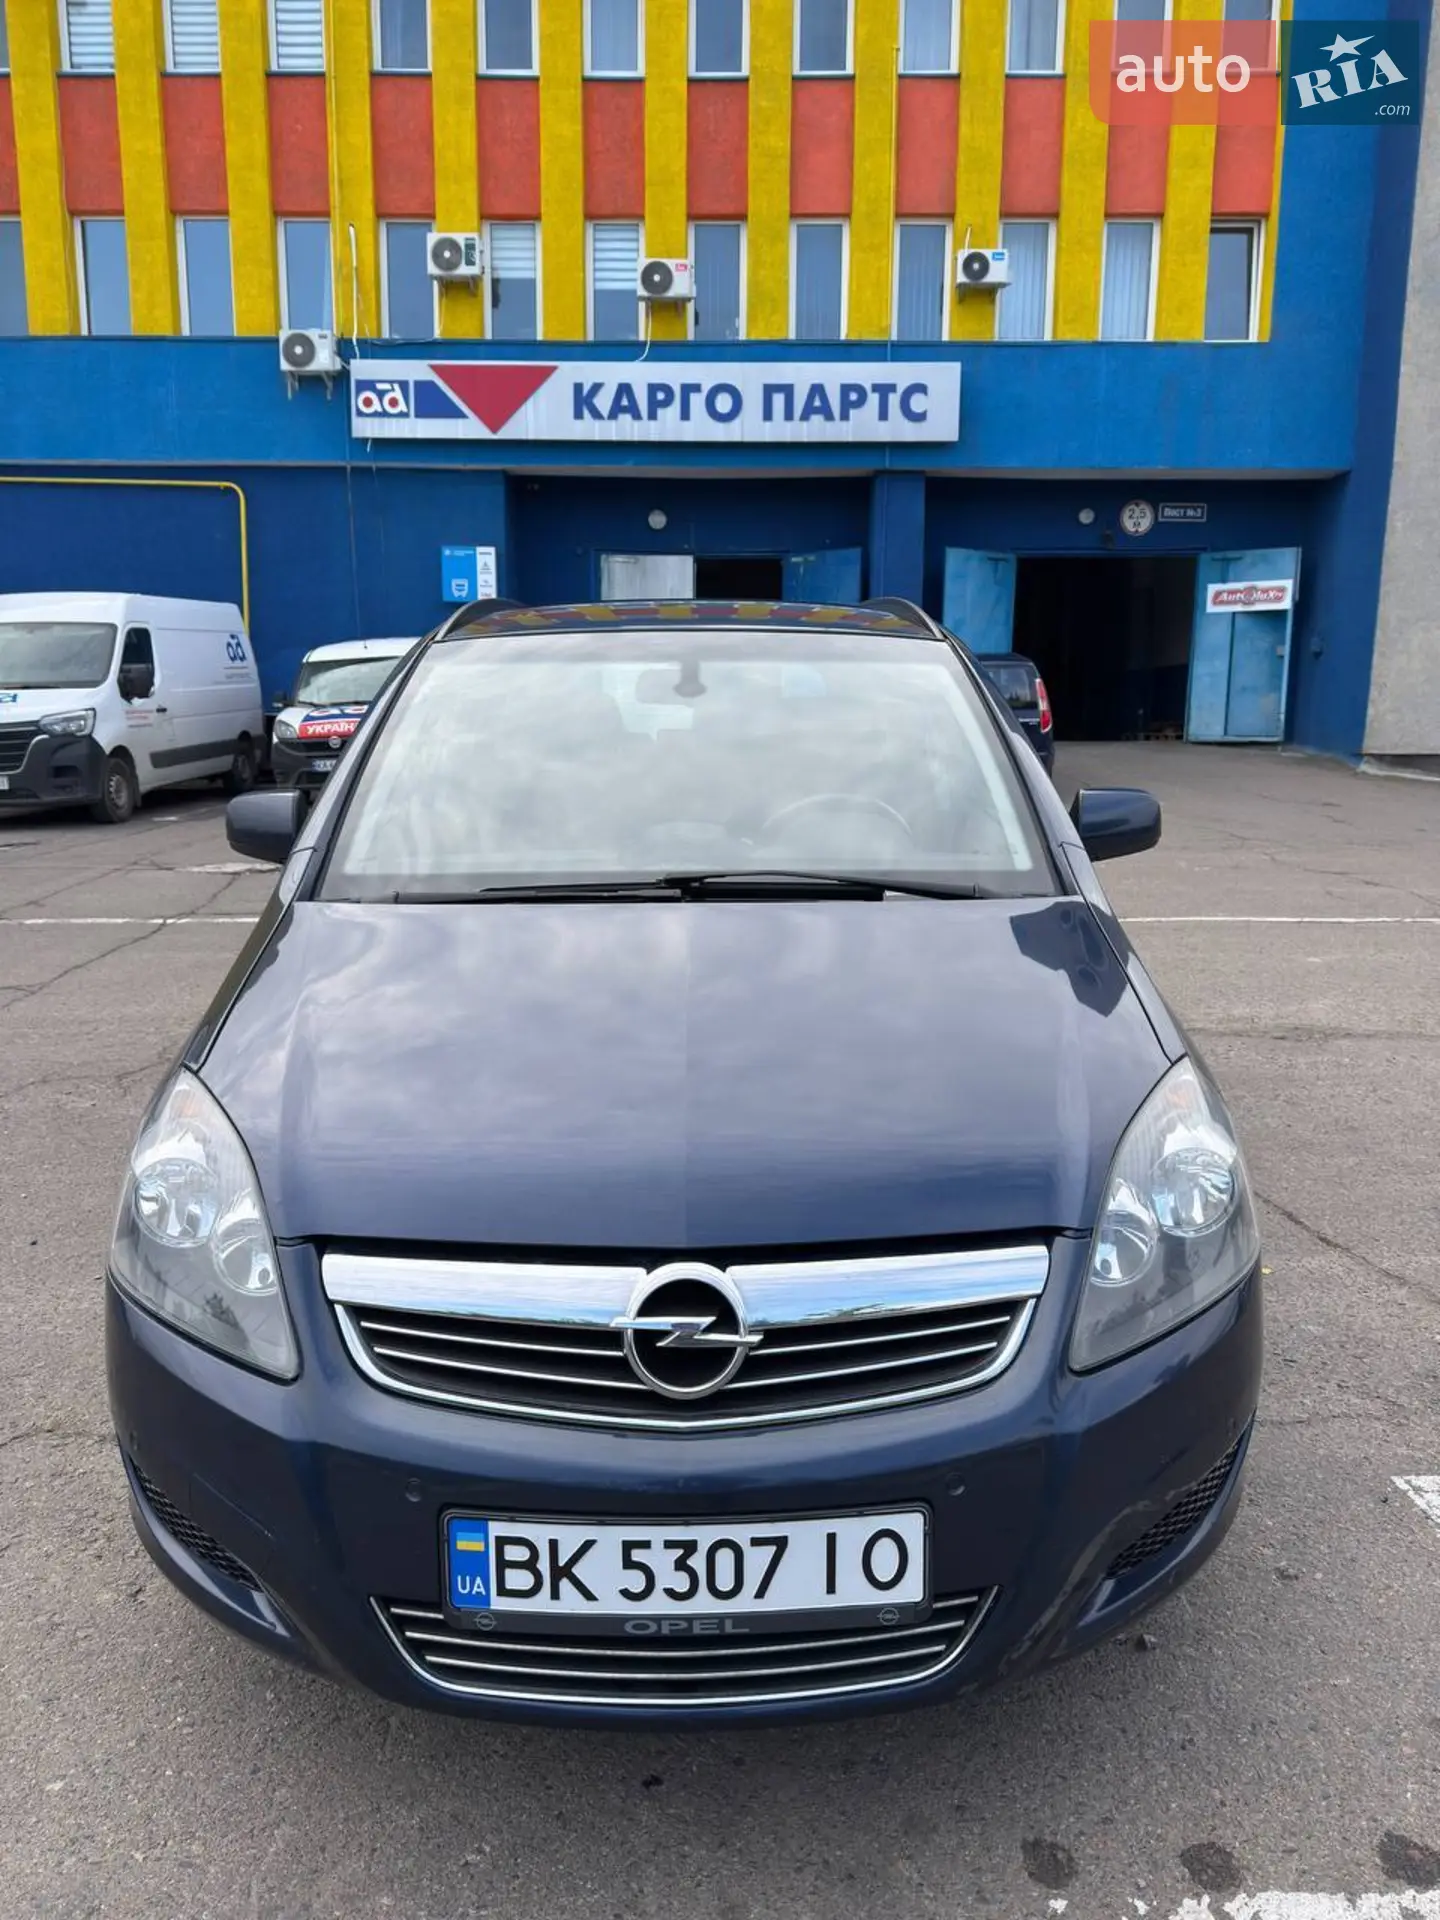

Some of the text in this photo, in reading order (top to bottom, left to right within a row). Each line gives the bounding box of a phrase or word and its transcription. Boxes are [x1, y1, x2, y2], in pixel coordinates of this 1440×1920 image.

[573, 382, 929, 423] КАРГО ПАРТС
[306, 721, 358, 735] УКРАЇН
[494, 1535, 599, 1602] BK
[618, 1535, 790, 1602] 5307
[457, 1575, 486, 1596] UA
[624, 1619, 750, 1635] OPEL
